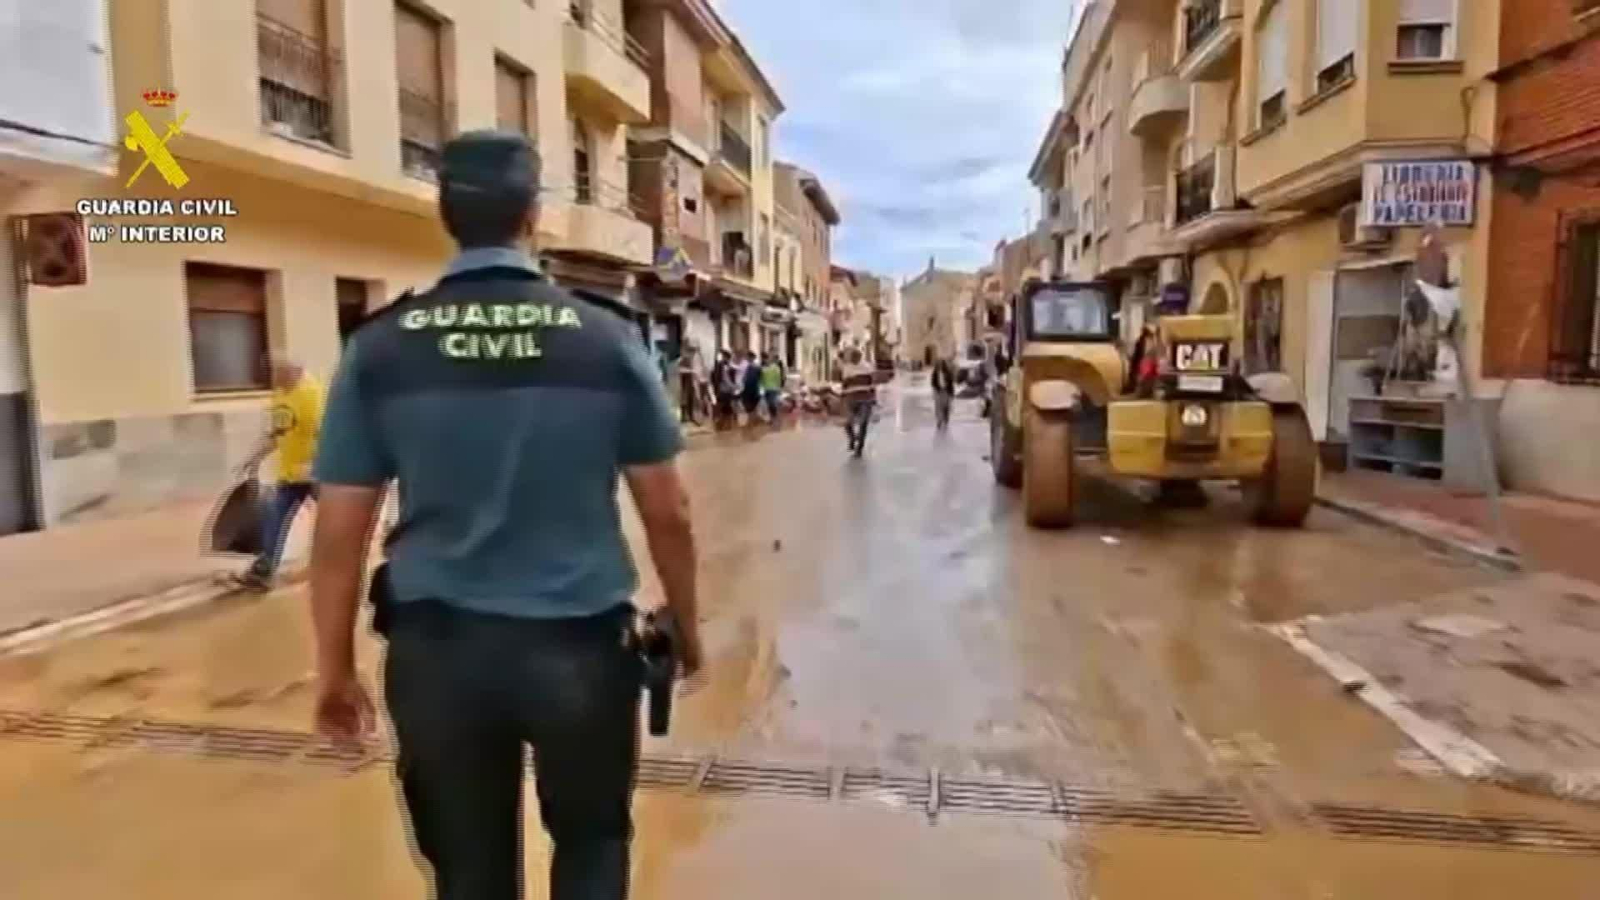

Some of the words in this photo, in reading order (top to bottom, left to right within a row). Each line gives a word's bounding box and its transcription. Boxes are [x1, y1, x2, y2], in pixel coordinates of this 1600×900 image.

[399, 303, 582, 330] GUARDIA
[438, 331, 543, 359] CIVIL
[1177, 344, 1223, 369] CAT
